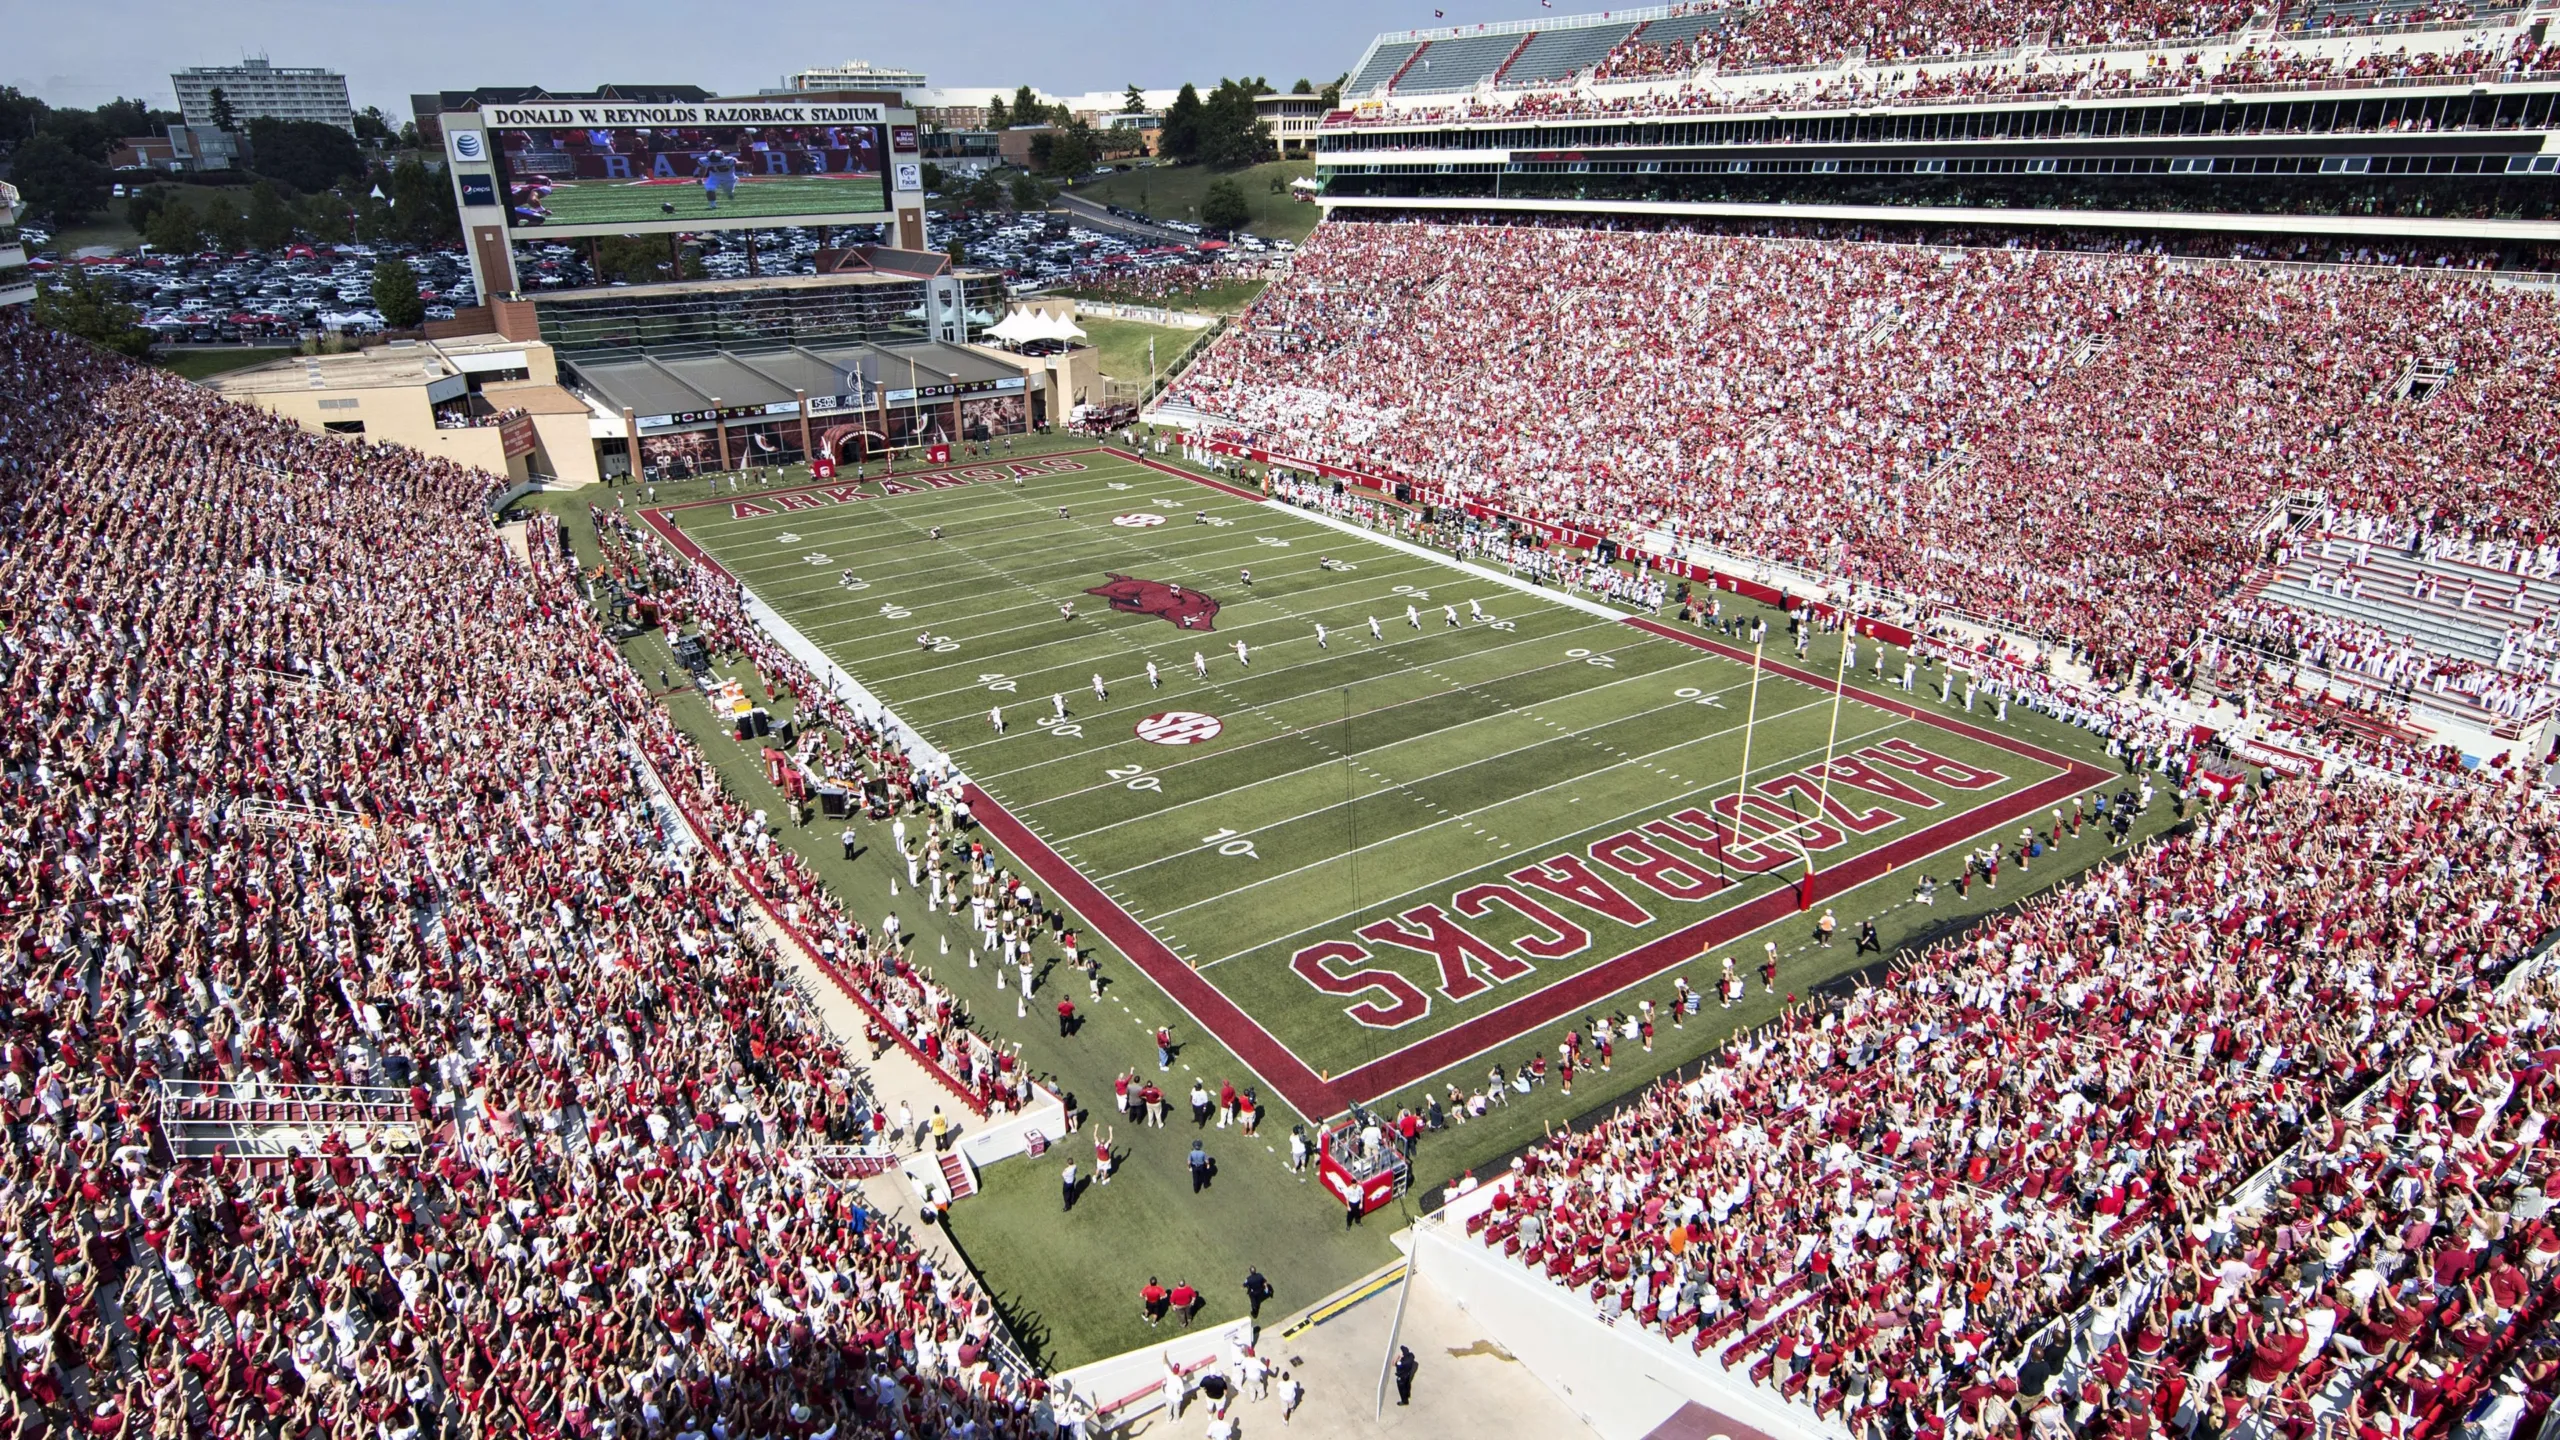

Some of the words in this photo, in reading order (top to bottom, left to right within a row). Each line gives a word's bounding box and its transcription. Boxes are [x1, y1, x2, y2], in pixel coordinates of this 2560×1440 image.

[496, 109, 573, 124] DONALD
[579, 109, 598, 123] W.
[604, 108, 697, 123] REYNOLDS
[704, 108, 805, 122] RAZORBACK
[811, 108, 878, 121] STADIUM
[472, 185, 491, 194] pepsi
[732, 458, 1088, 519] ARKANSAS
[803, 552, 834, 565] 20
[880, 603, 912, 619] 40
[929, 636, 960, 652] 50
[1565, 649, 1615, 669] 20
[977, 673, 1016, 691] 40
[1674, 688, 1722, 706] 10
[1037, 714, 1082, 737] 30
[1135, 711, 1223, 745] SEC
[1105, 764, 1160, 791] 20
[1202, 828, 1256, 857] 10
[1289, 737, 2010, 1029] RAZORBACKS
